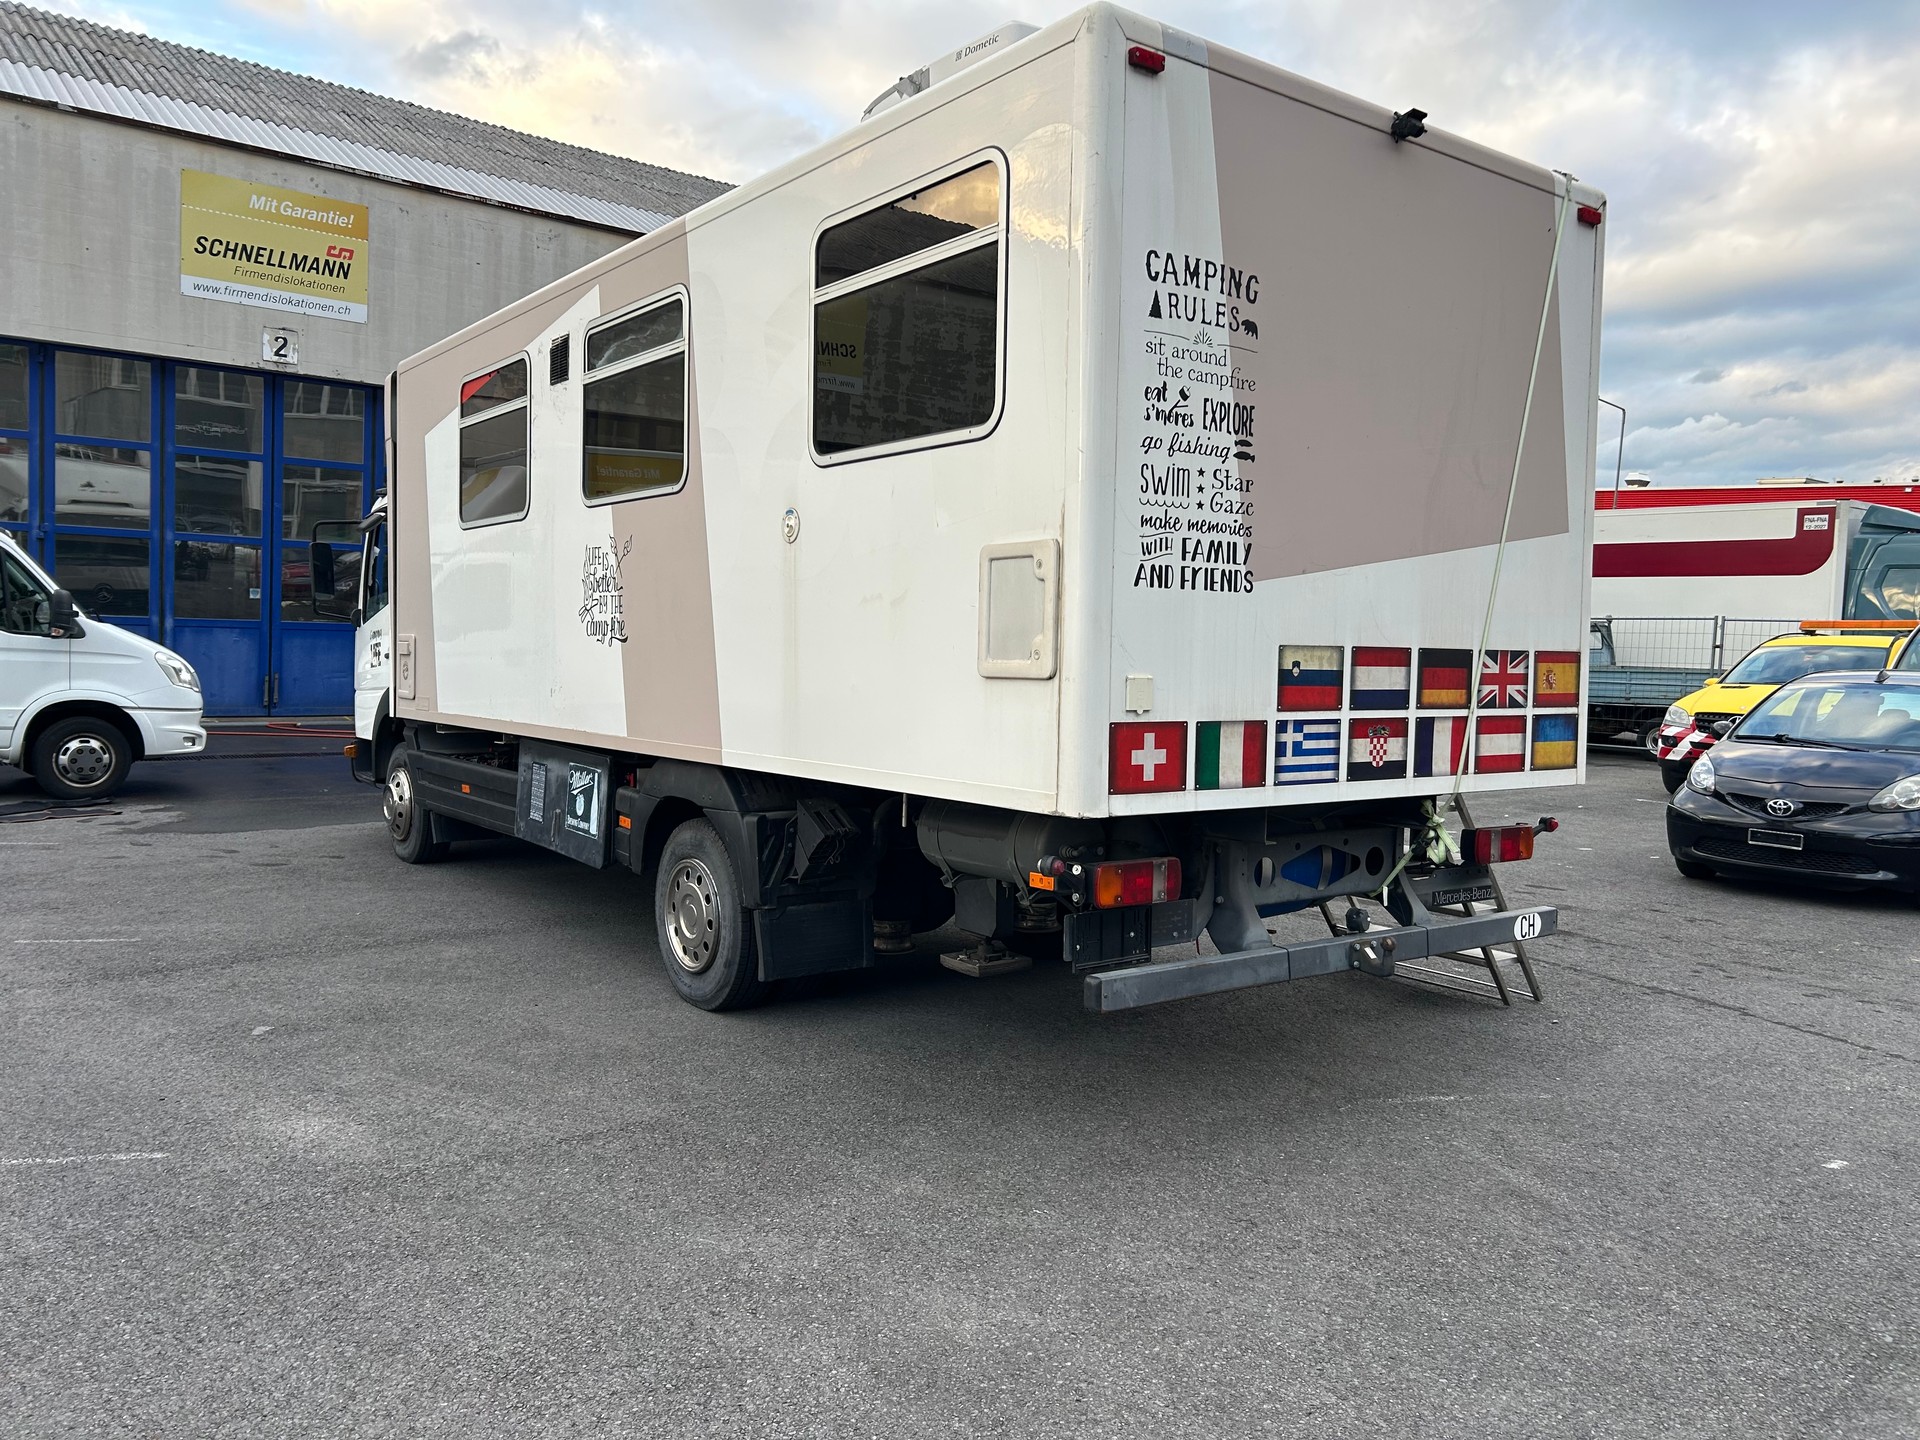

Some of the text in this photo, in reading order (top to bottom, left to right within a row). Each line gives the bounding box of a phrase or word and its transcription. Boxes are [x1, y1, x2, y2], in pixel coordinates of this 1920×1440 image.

[964, 34, 999, 57] Dometic
[249, 194, 354, 228] Mit Garantie!
[193, 235, 351, 280] SCHNELLMANN
[233, 265, 345, 293] Firmendislokationen
[1145, 249, 1260, 304] CAMPING
[193, 282, 351, 315] www.firmendislokationen.ch
[1167, 292, 1240, 332] RULES
[273, 336, 288, 358] 2
[1145, 335, 1227, 367] sit around
[1157, 357, 1257, 392] the campfire
[1144, 380, 1168, 403] eat
[1203, 398, 1256, 438] EXPLORE
[1140, 432, 1231, 464] go fishing
[1212, 468, 1254, 493] Star
[1210, 491, 1254, 516] Gaze
[1140, 509, 1253, 538] make memories
[602, 552, 610, 571] IS
[1141, 536, 1252, 566] WITH FAMILY
[1133, 563, 1174, 589] AND
[598, 594, 623, 614] BY THE
[569, 770, 593, 791] Miller
[1434, 887, 1491, 905] Mercedes-Benz
[1520, 913, 1535, 938] CH
